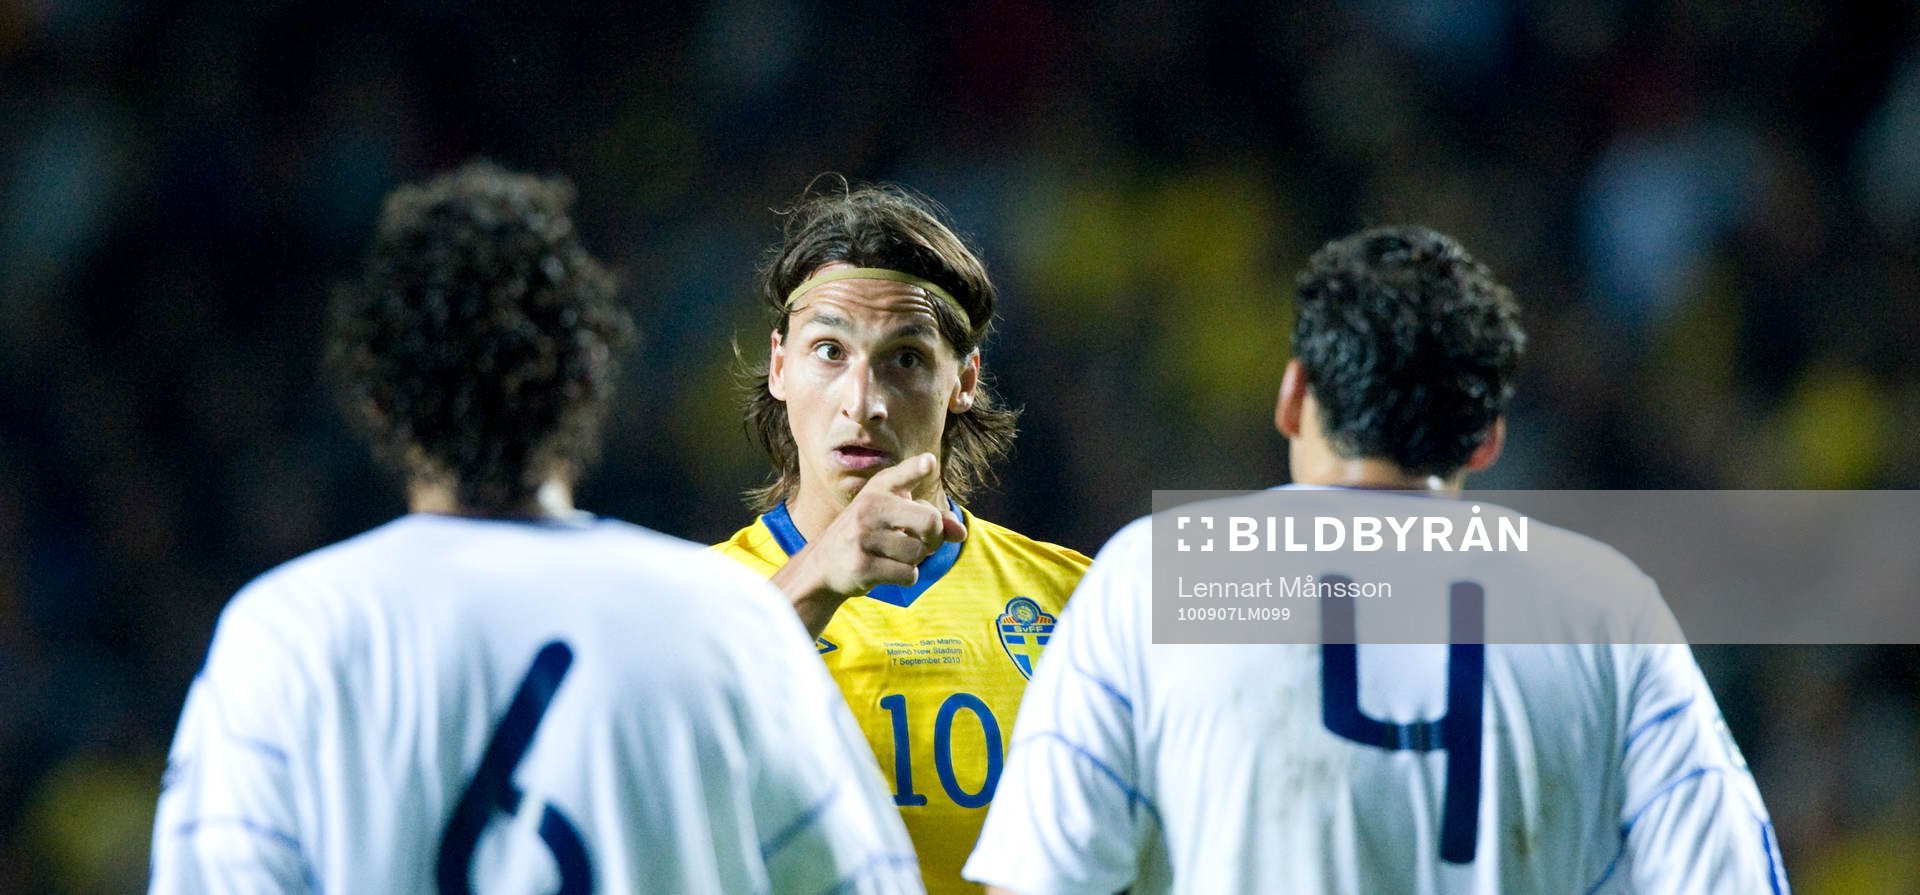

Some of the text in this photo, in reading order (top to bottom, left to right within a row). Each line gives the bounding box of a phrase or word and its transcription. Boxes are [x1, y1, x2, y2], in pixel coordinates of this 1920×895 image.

[880, 692, 1004, 808] 10
[899, 657, 940, 667] September
[1320, 574, 1486, 864] 4
[437, 640, 594, 895] 6
